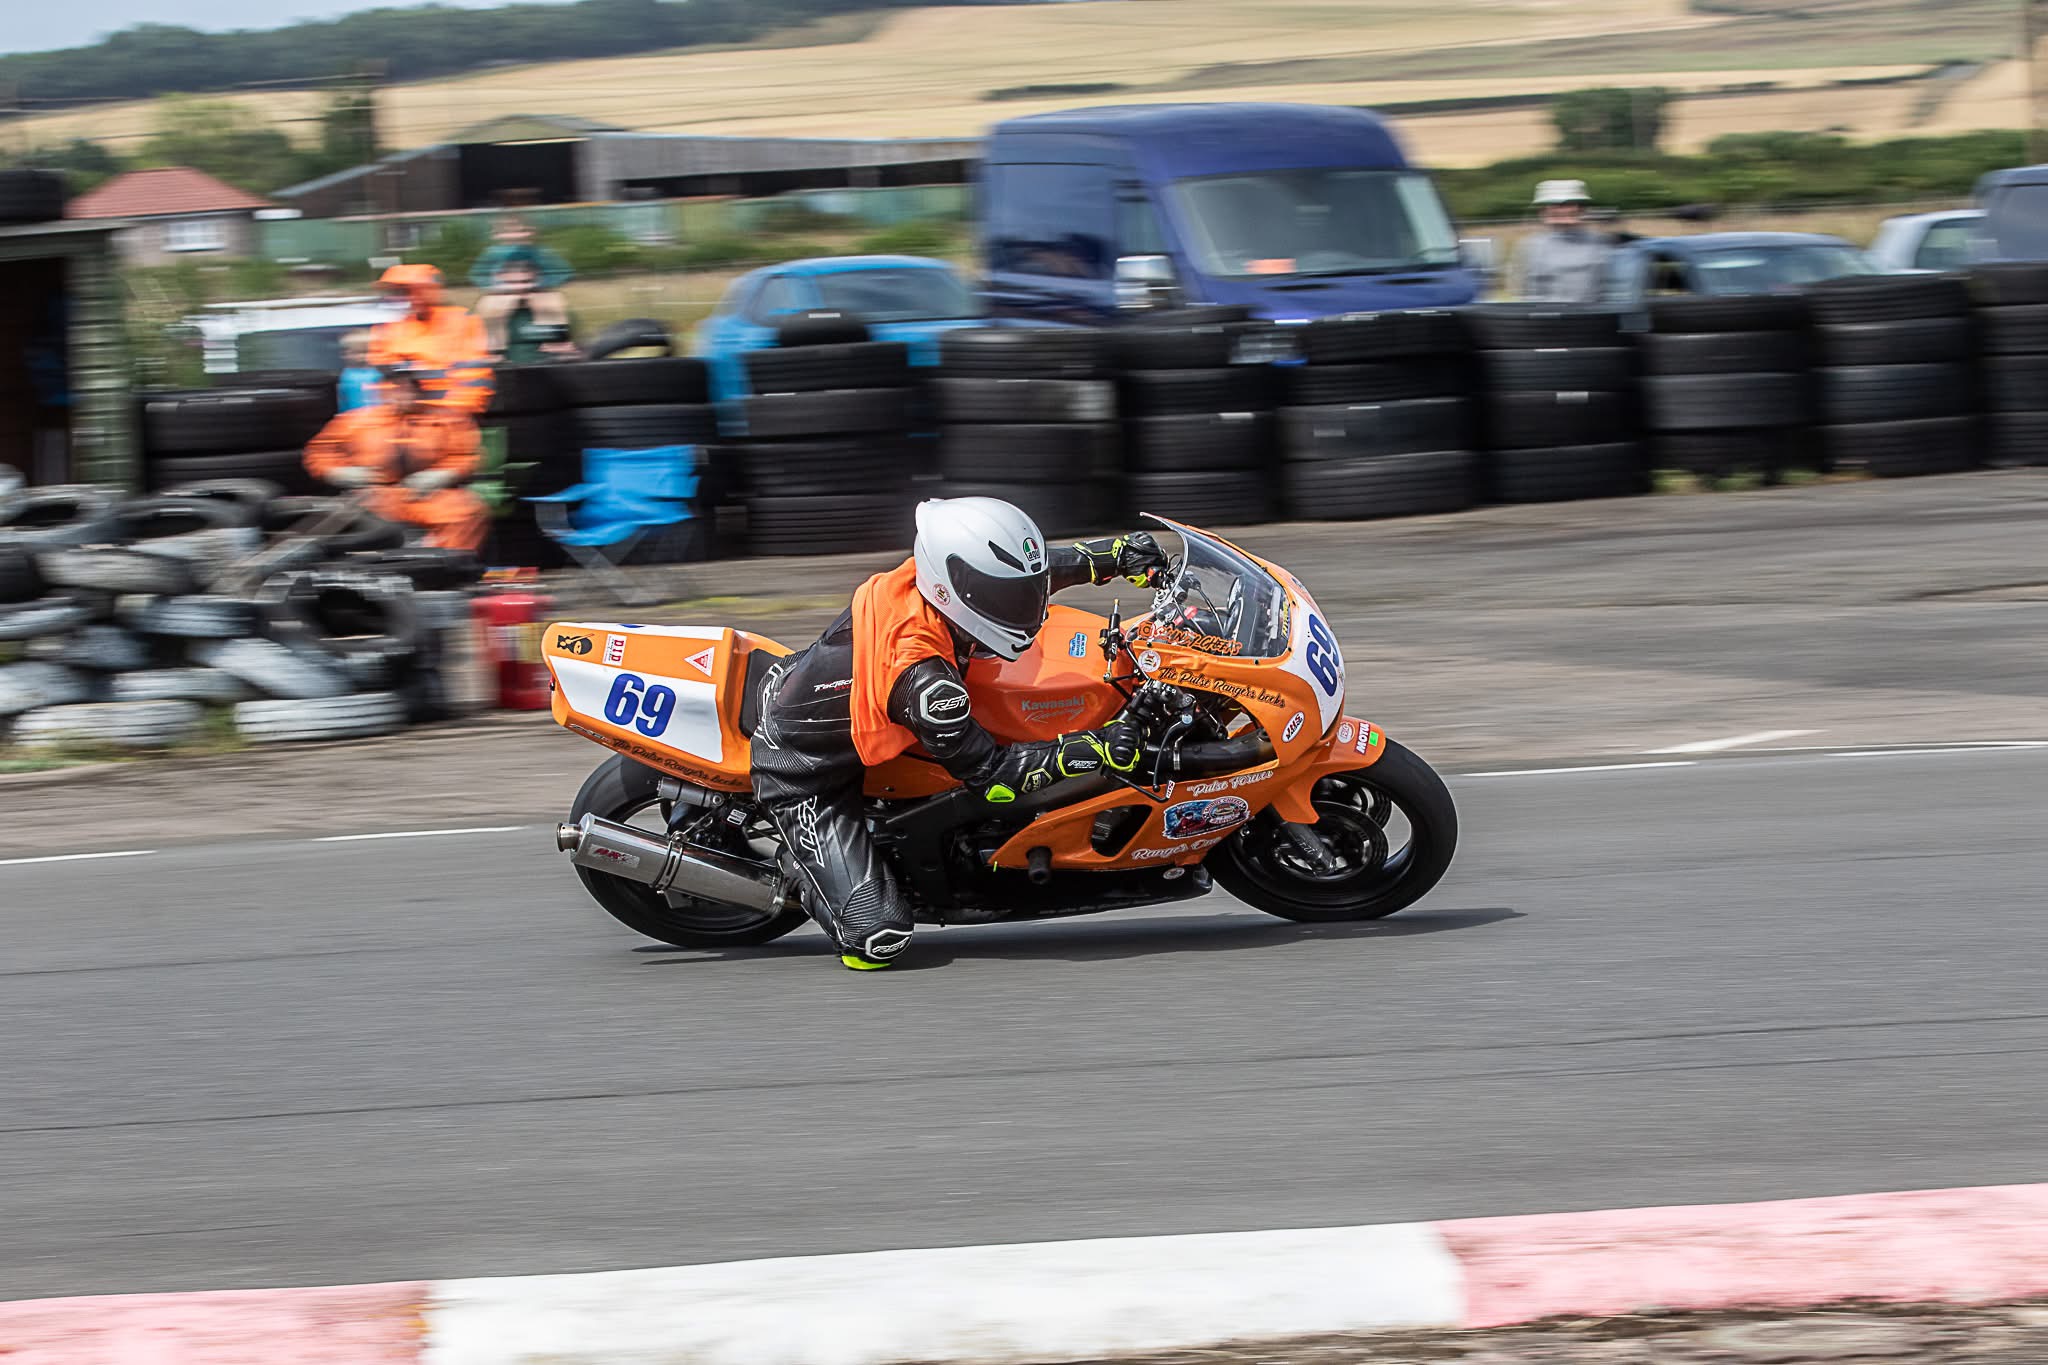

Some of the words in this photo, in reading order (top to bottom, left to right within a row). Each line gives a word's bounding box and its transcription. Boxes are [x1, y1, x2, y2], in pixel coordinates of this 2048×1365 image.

[611, 639, 625, 662] DID
[1306, 613, 1340, 697] 69
[1159, 667, 1177, 680] The
[1179, 671, 1211, 688] Pulse
[1213, 679, 1257, 699] Rangers
[604, 673, 677, 737] 69
[928, 694, 969, 713] RST
[1021, 695, 1085, 711] Kawasaki
